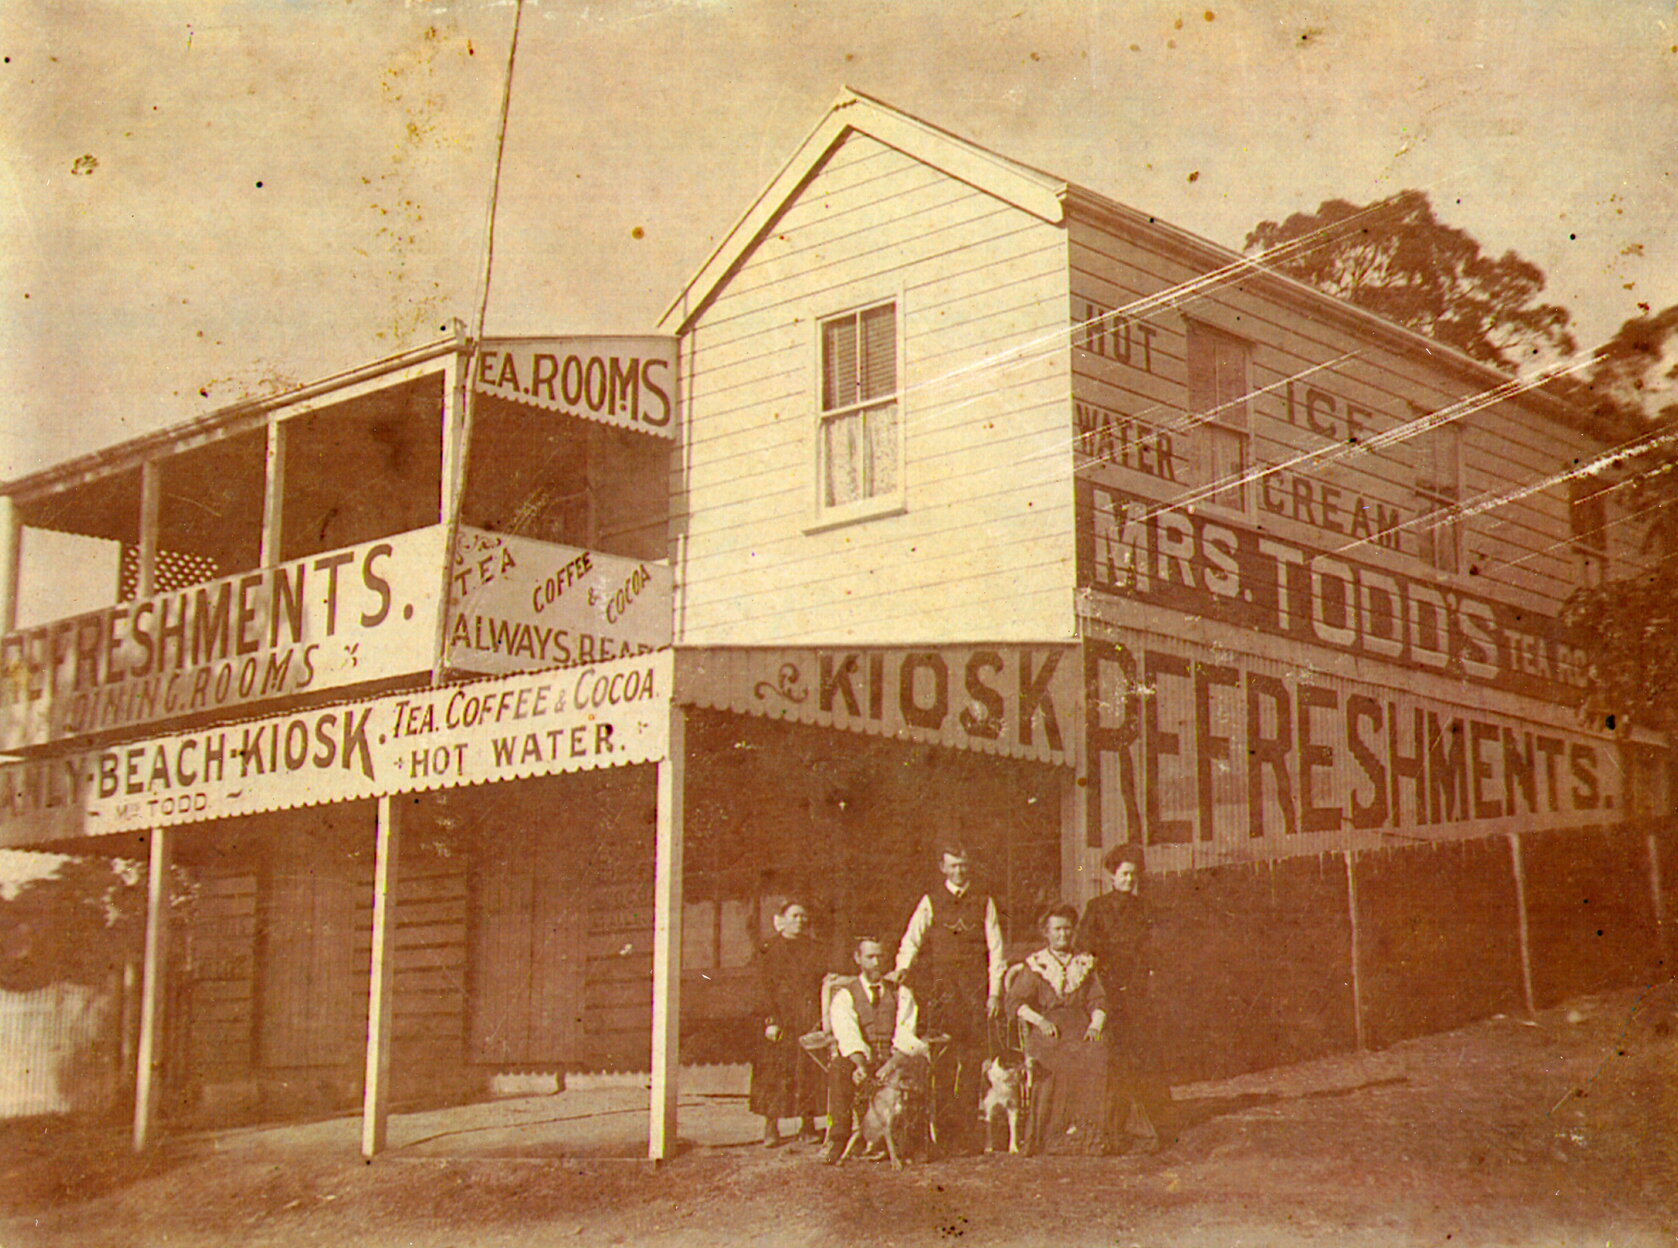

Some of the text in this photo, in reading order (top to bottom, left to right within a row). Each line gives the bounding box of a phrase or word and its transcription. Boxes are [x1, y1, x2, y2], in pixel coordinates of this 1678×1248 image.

[1086, 304, 1157, 373] HOT
[1075, 402, 1175, 482] WATER
[1286, 380, 1373, 447] ICE
[1262, 470, 1401, 549] CREAM
[454, 547, 516, 596] TEA
[532, 552, 594, 613] COFFEE
[606, 564, 652, 624] COCOA
[1093, 488, 1253, 603] MRS.
[1258, 537, 1499, 681] TODD'S
[1504, 628, 1550, 679] TEA
[446, 685, 551, 730] COFFEE
[554, 689, 566, 713] &
[819, 650, 1064, 752] KIOSK
[410, 723, 625, 779] HOT WATER.
[1084, 637, 1615, 849] REFRESHMENTS.
[147, 792, 208, 817] TODD
